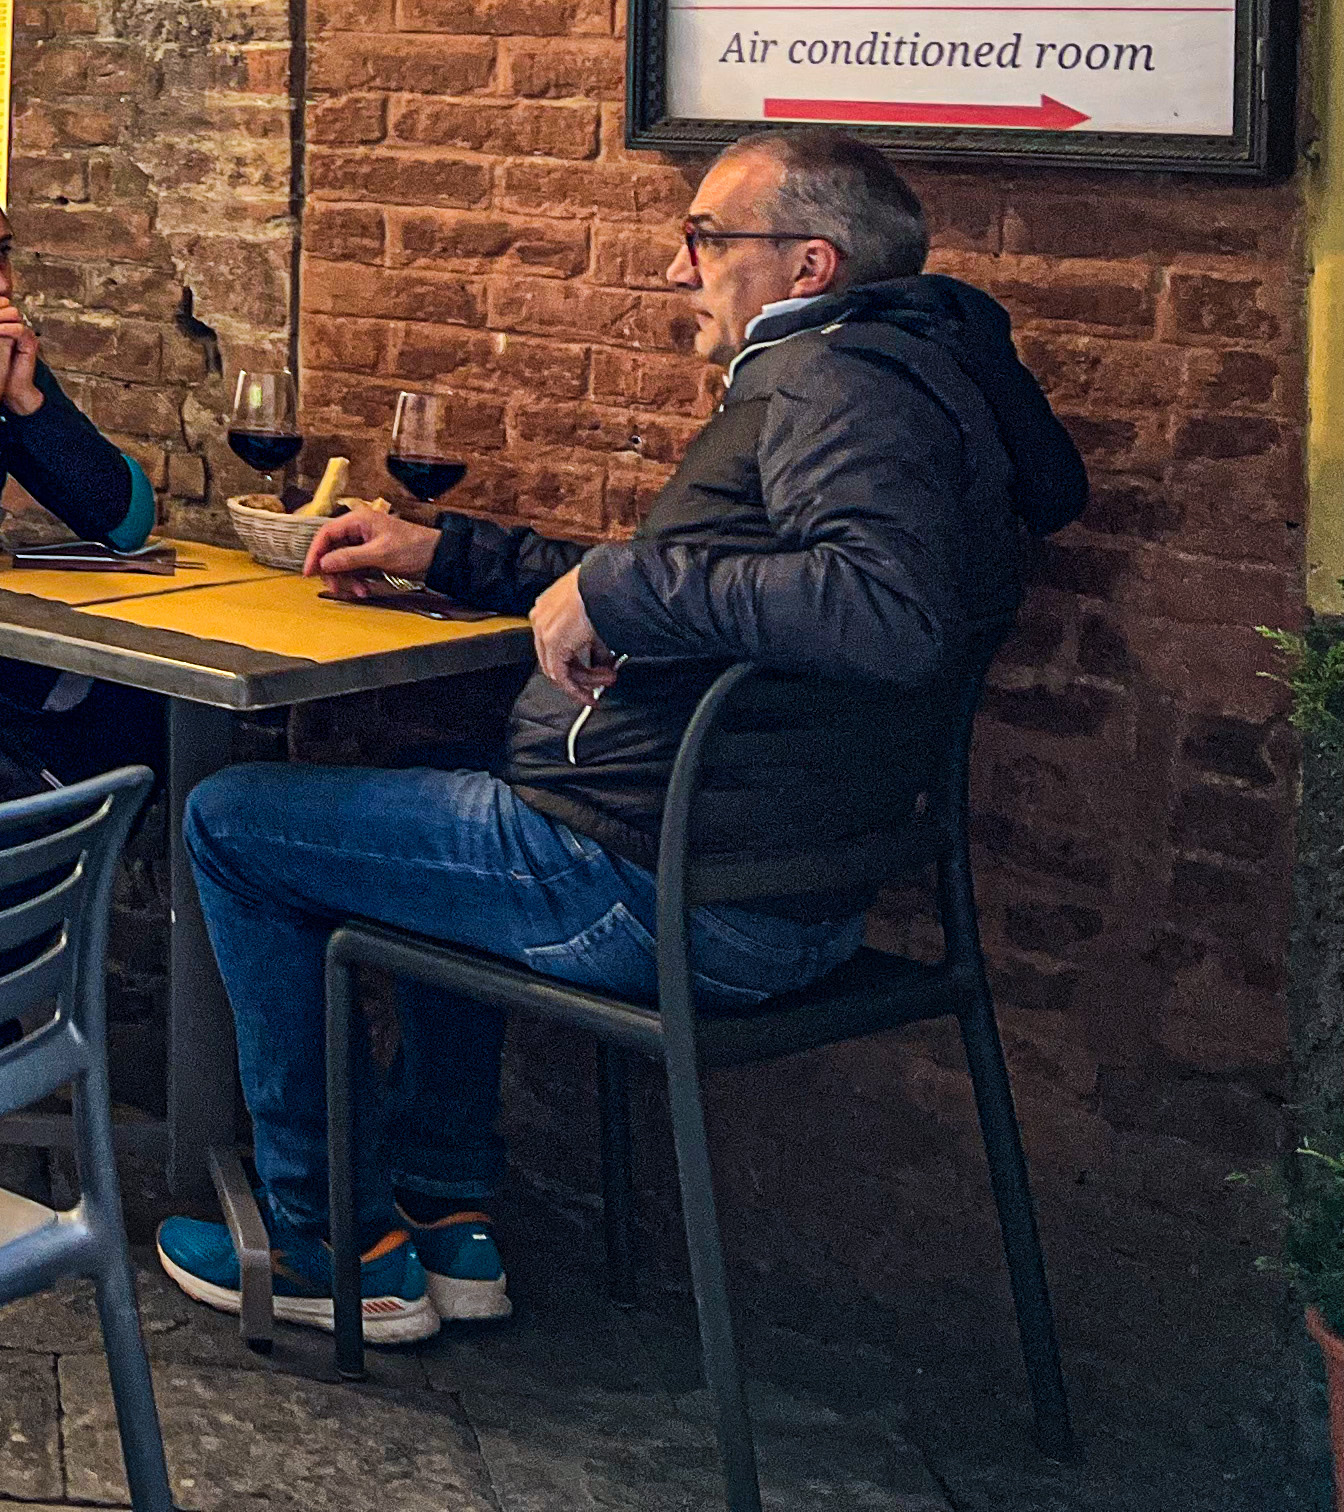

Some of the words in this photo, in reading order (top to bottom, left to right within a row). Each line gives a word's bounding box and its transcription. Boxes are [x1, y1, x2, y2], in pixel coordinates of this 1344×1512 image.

[719, 30, 778, 64] Air
[787, 31, 1023, 69] conditioned
[1034, 38, 1156, 72] room
